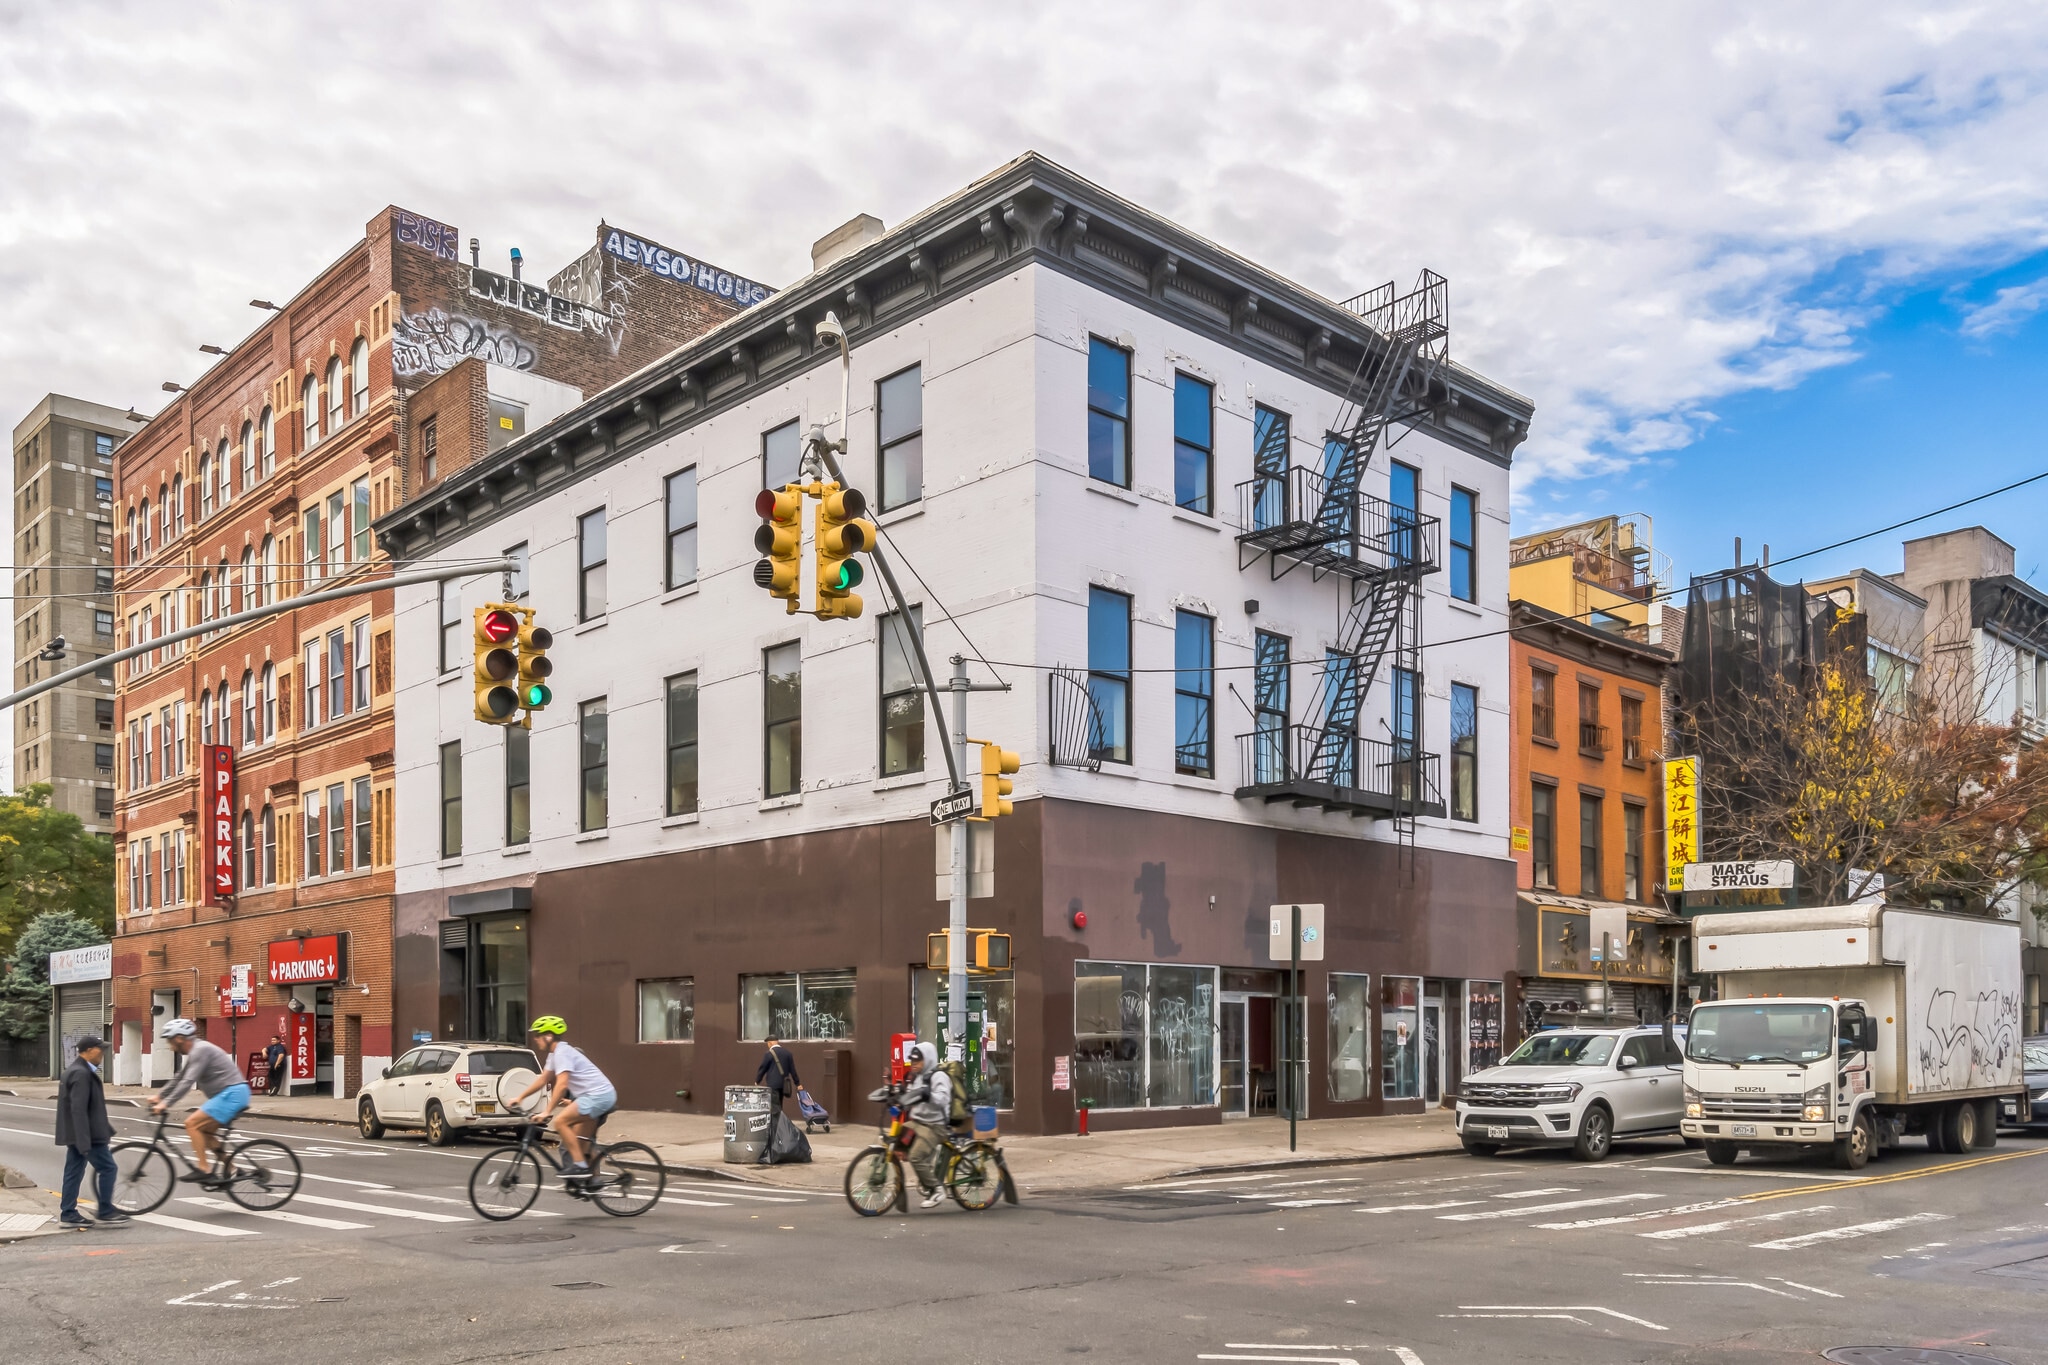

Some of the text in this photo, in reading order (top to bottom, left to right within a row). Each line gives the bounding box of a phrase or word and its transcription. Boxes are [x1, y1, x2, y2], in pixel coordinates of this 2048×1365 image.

[398, 211, 458, 261] BISK
[605, 231, 780, 303] AEYSO HOUS
[216, 770, 232, 867] PARK
[936, 797, 968, 816] ONE WAY
[1671, 767, 1692, 863] 長江餅城
[1711, 863, 1756, 876] MARC
[1711, 874, 1769, 887] STRAUS
[279, 958, 325, 980] PARKING
[298, 1026, 308, 1066] PARK
[250, 1076, 266, 1088] 18
